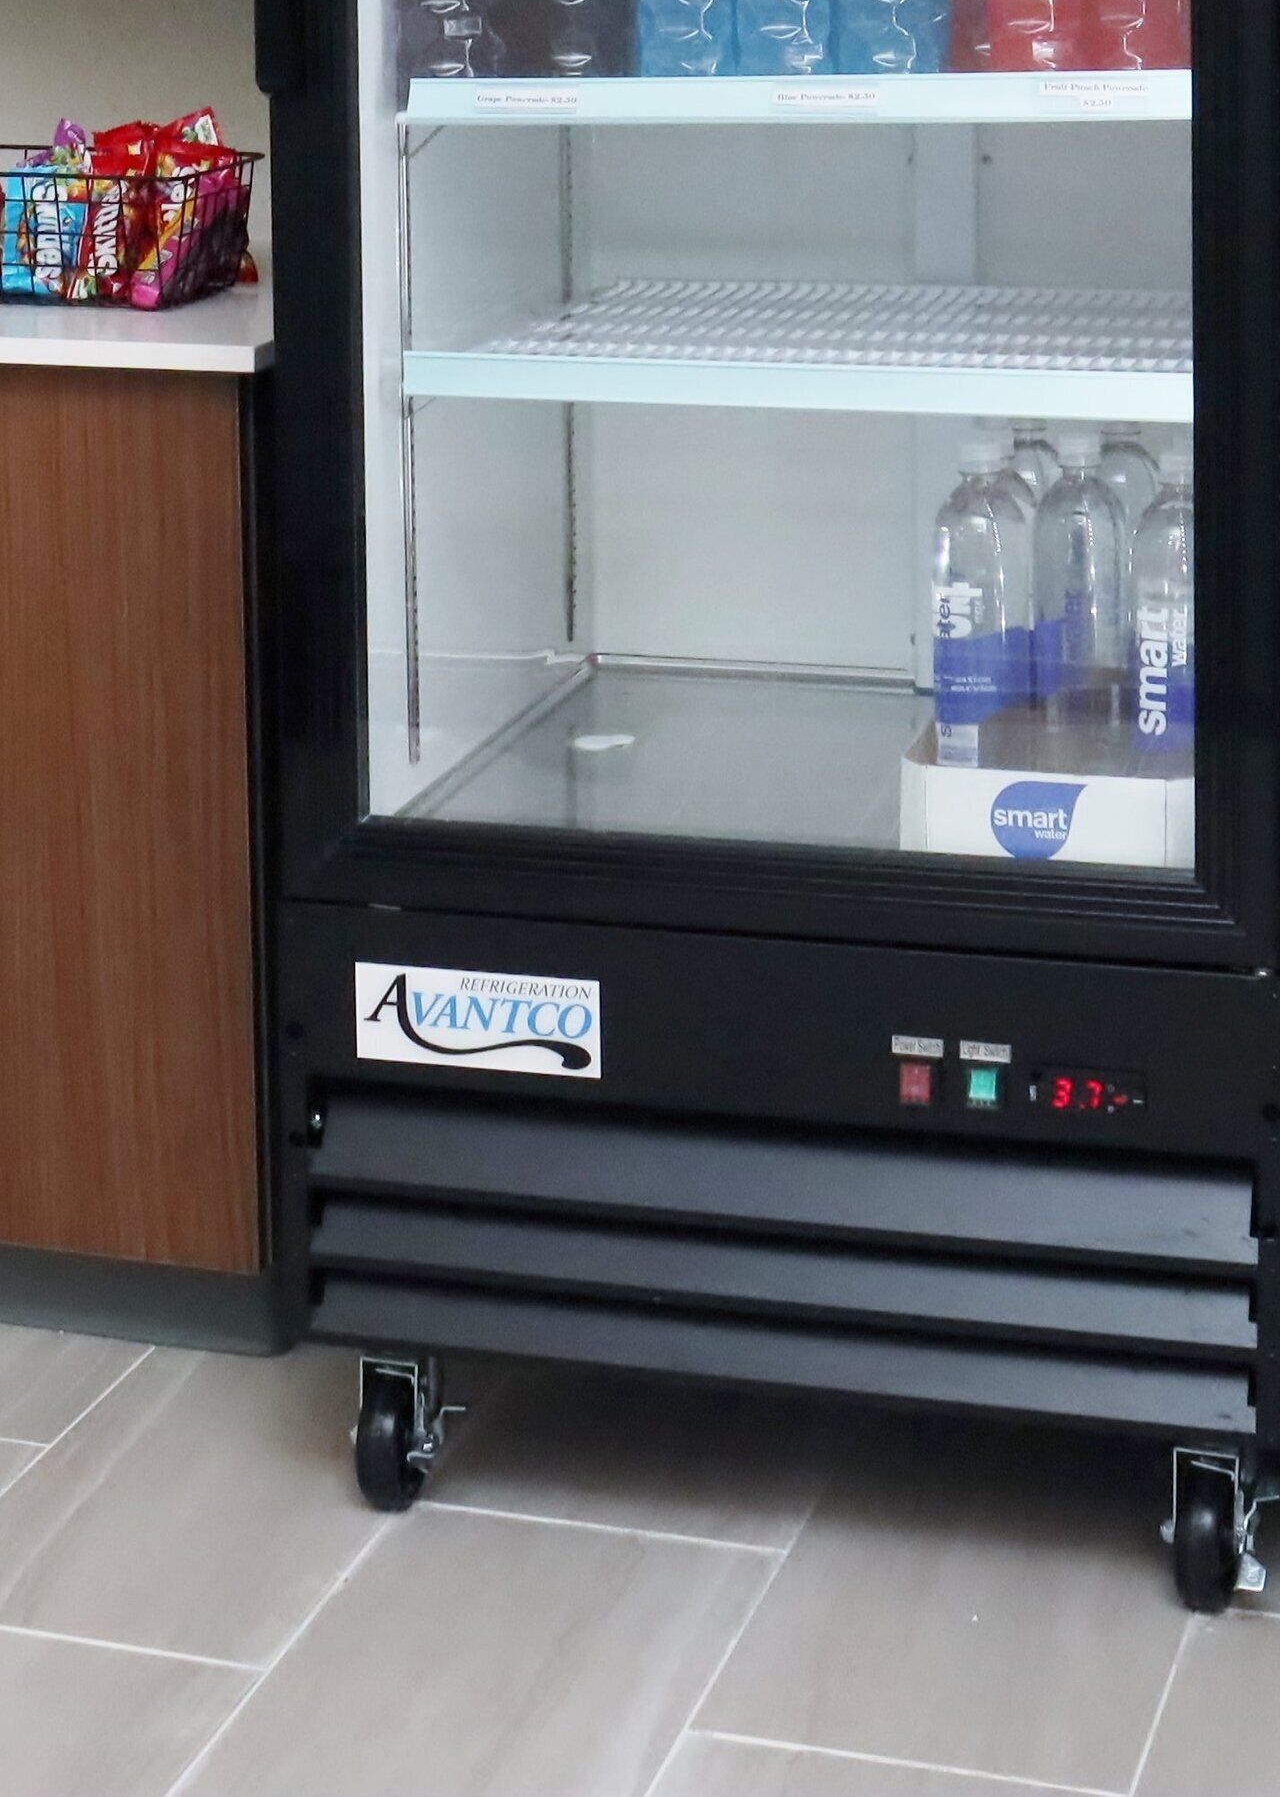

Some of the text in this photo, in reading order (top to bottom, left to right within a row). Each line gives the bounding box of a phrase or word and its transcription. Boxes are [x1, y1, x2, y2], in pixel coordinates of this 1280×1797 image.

[1138, 605, 1169, 737] smart
[993, 808, 1068, 829] smart
[1034, 828, 1067, 841] water
[460, 977, 593, 1000] REFRIGERATION
[363, 972, 593, 1041] AVANTCO
[1051, 1077, 1104, 1109] 37
